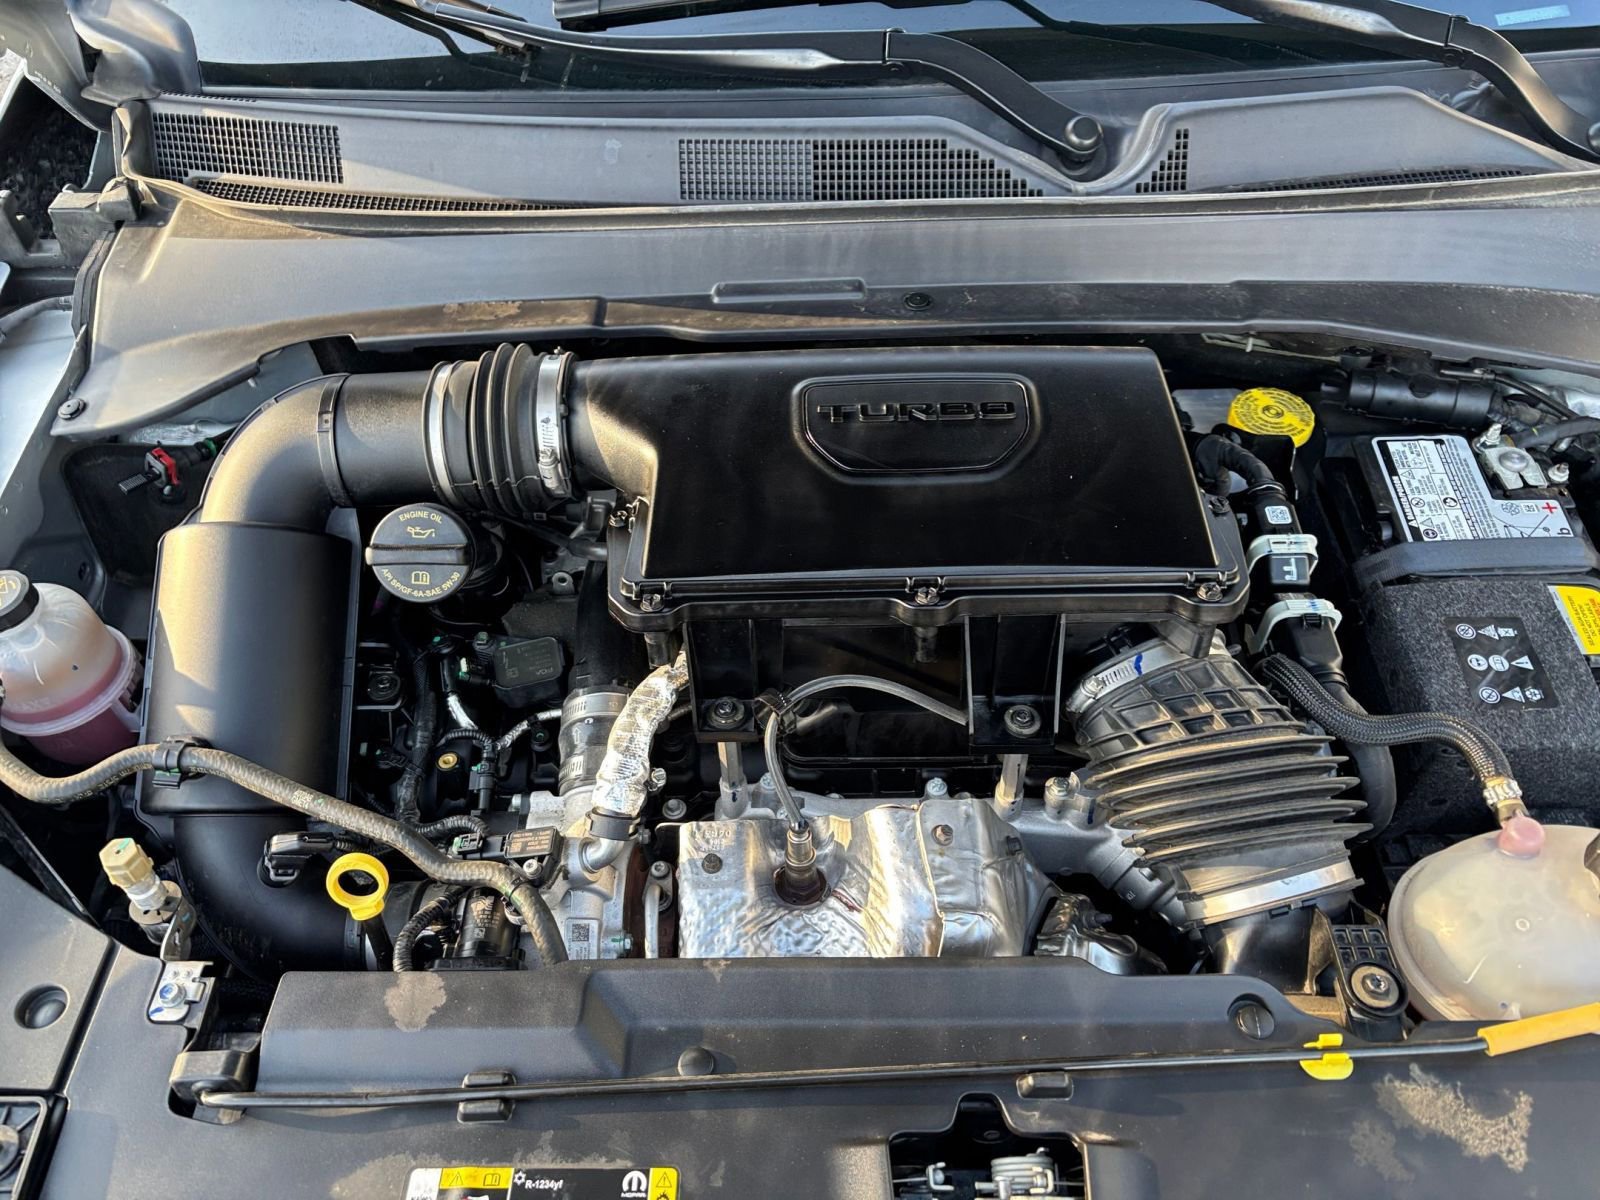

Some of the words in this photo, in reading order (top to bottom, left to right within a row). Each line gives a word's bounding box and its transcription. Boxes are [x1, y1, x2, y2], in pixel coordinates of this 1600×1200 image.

[816, 402, 1017, 423] TURBO
[399, 510, 429, 522] ENGINE
[430, 513, 443, 524] OIL
[381, 568, 394, 581] API
[442, 571, 460, 590] 5W-30
[525, 1179, 564, 1191] R-1234yf
